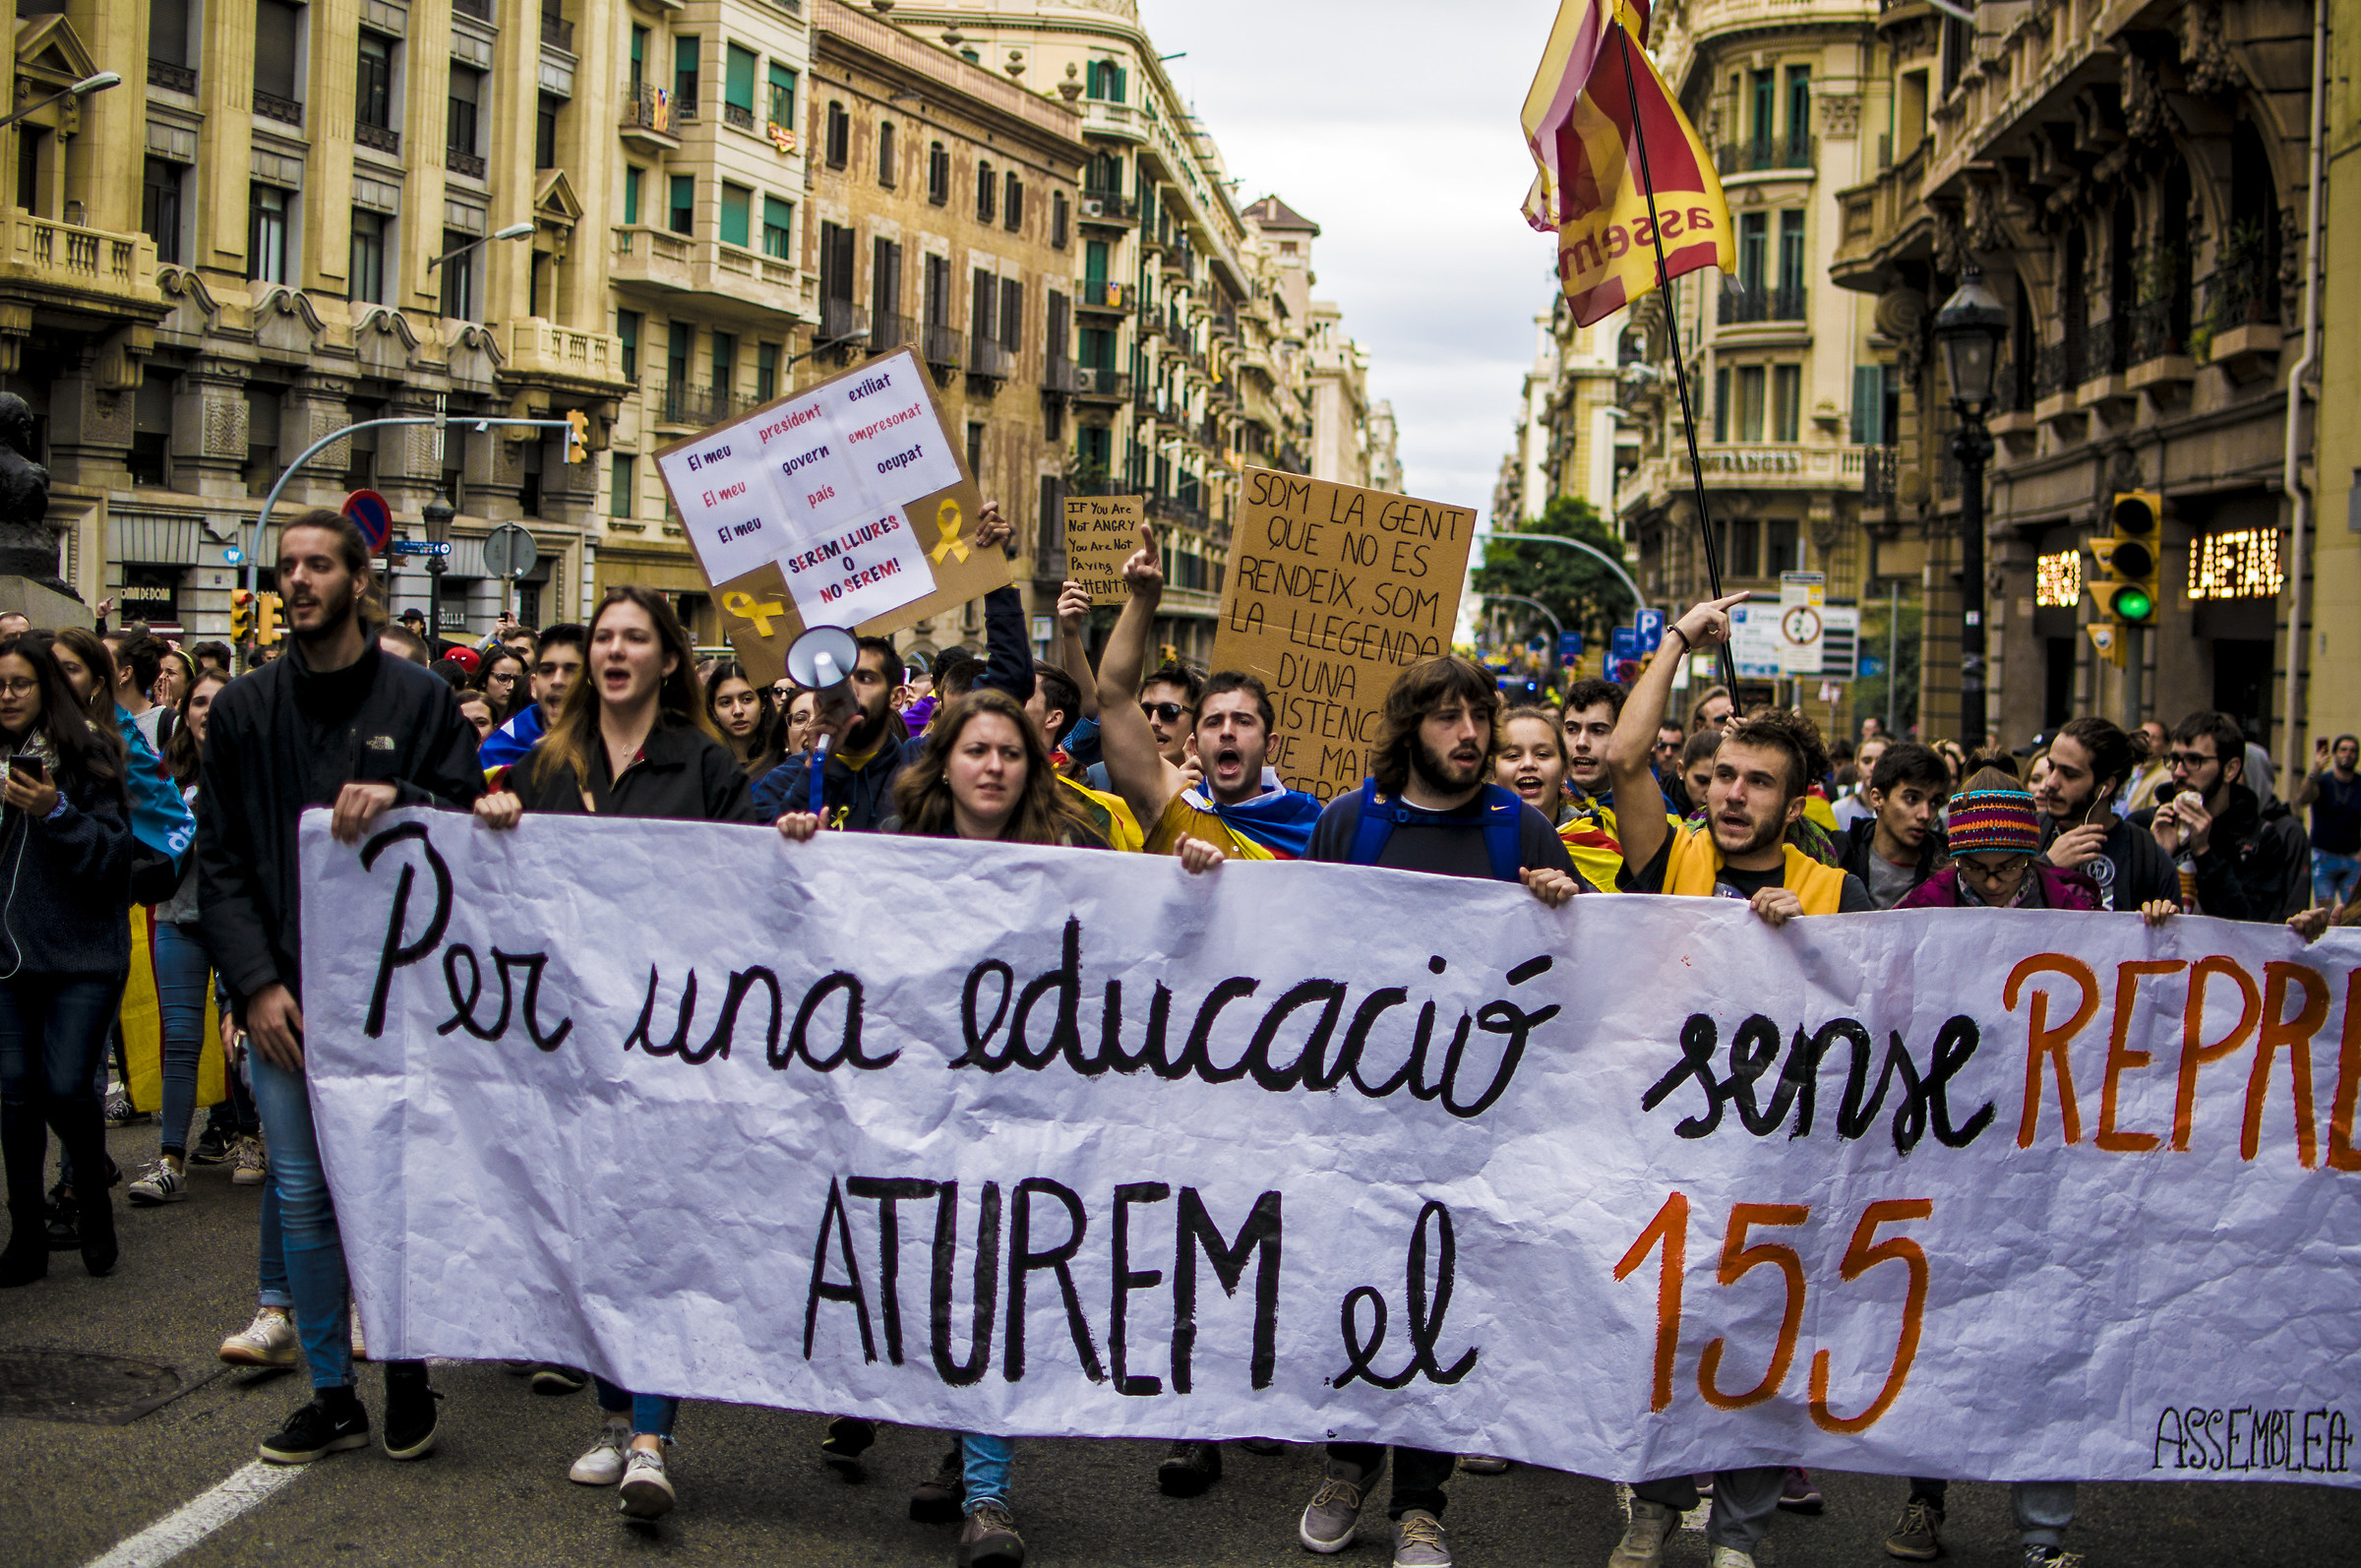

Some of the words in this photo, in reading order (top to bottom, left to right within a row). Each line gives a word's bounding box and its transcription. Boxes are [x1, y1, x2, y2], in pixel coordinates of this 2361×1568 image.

[688, 453, 702, 471] El
[703, 446, 731, 464] meu
[757, 403, 822, 445] president
[848, 373, 891, 402] exiliat
[702, 490, 717, 509] El
[718, 481, 746, 501] meu
[782, 446, 830, 476] govern
[848, 402, 922, 444] empresonat
[717, 525, 733, 544] El
[733, 517, 761, 537] meu
[807, 484, 835, 510] país
[877, 444, 923, 474] ocupat
[1067, 502, 1088, 513] IF
[1247, 473, 1311, 514] SOM
[1330, 489, 1364, 527] LA
[1379, 501, 1465, 541] GENT
[788, 540, 841, 573] SEREM
[840, 514, 900, 551] LLIURES
[1068, 537, 1088, 553] You
[1092, 519, 1135, 532] ANGRY
[1267, 515, 1324, 556] QUE
[1341, 531, 1378, 567] NO
[1391, 541, 1430, 577] ES
[819, 583, 843, 604] NO
[843, 557, 901, 593] SEREM!
[842, 556, 855, 572] O
[1231, 598, 1264, 635] LA
[1290, 610, 1439, 667] LLEGENDA
[1371, 582, 1439, 628] SOM
[1641, 614, 1658, 634] P
[1277, 651, 1357, 699] D'UNA
[1266, 692, 1383, 743] ISTÈNC
[359, 820, 573, 1052] Per
[624, 962, 903, 1071] una
[947, 913, 1562, 1118] educació
[1641, 1012, 1997, 1159] sense
[803, 1174, 1283, 1396] ATUREM
[1333, 1199, 1480, 1390] el
[1613, 1190, 1934, 1435] 155
[2152, 1405, 2355, 1474] ASSEMBLEA
